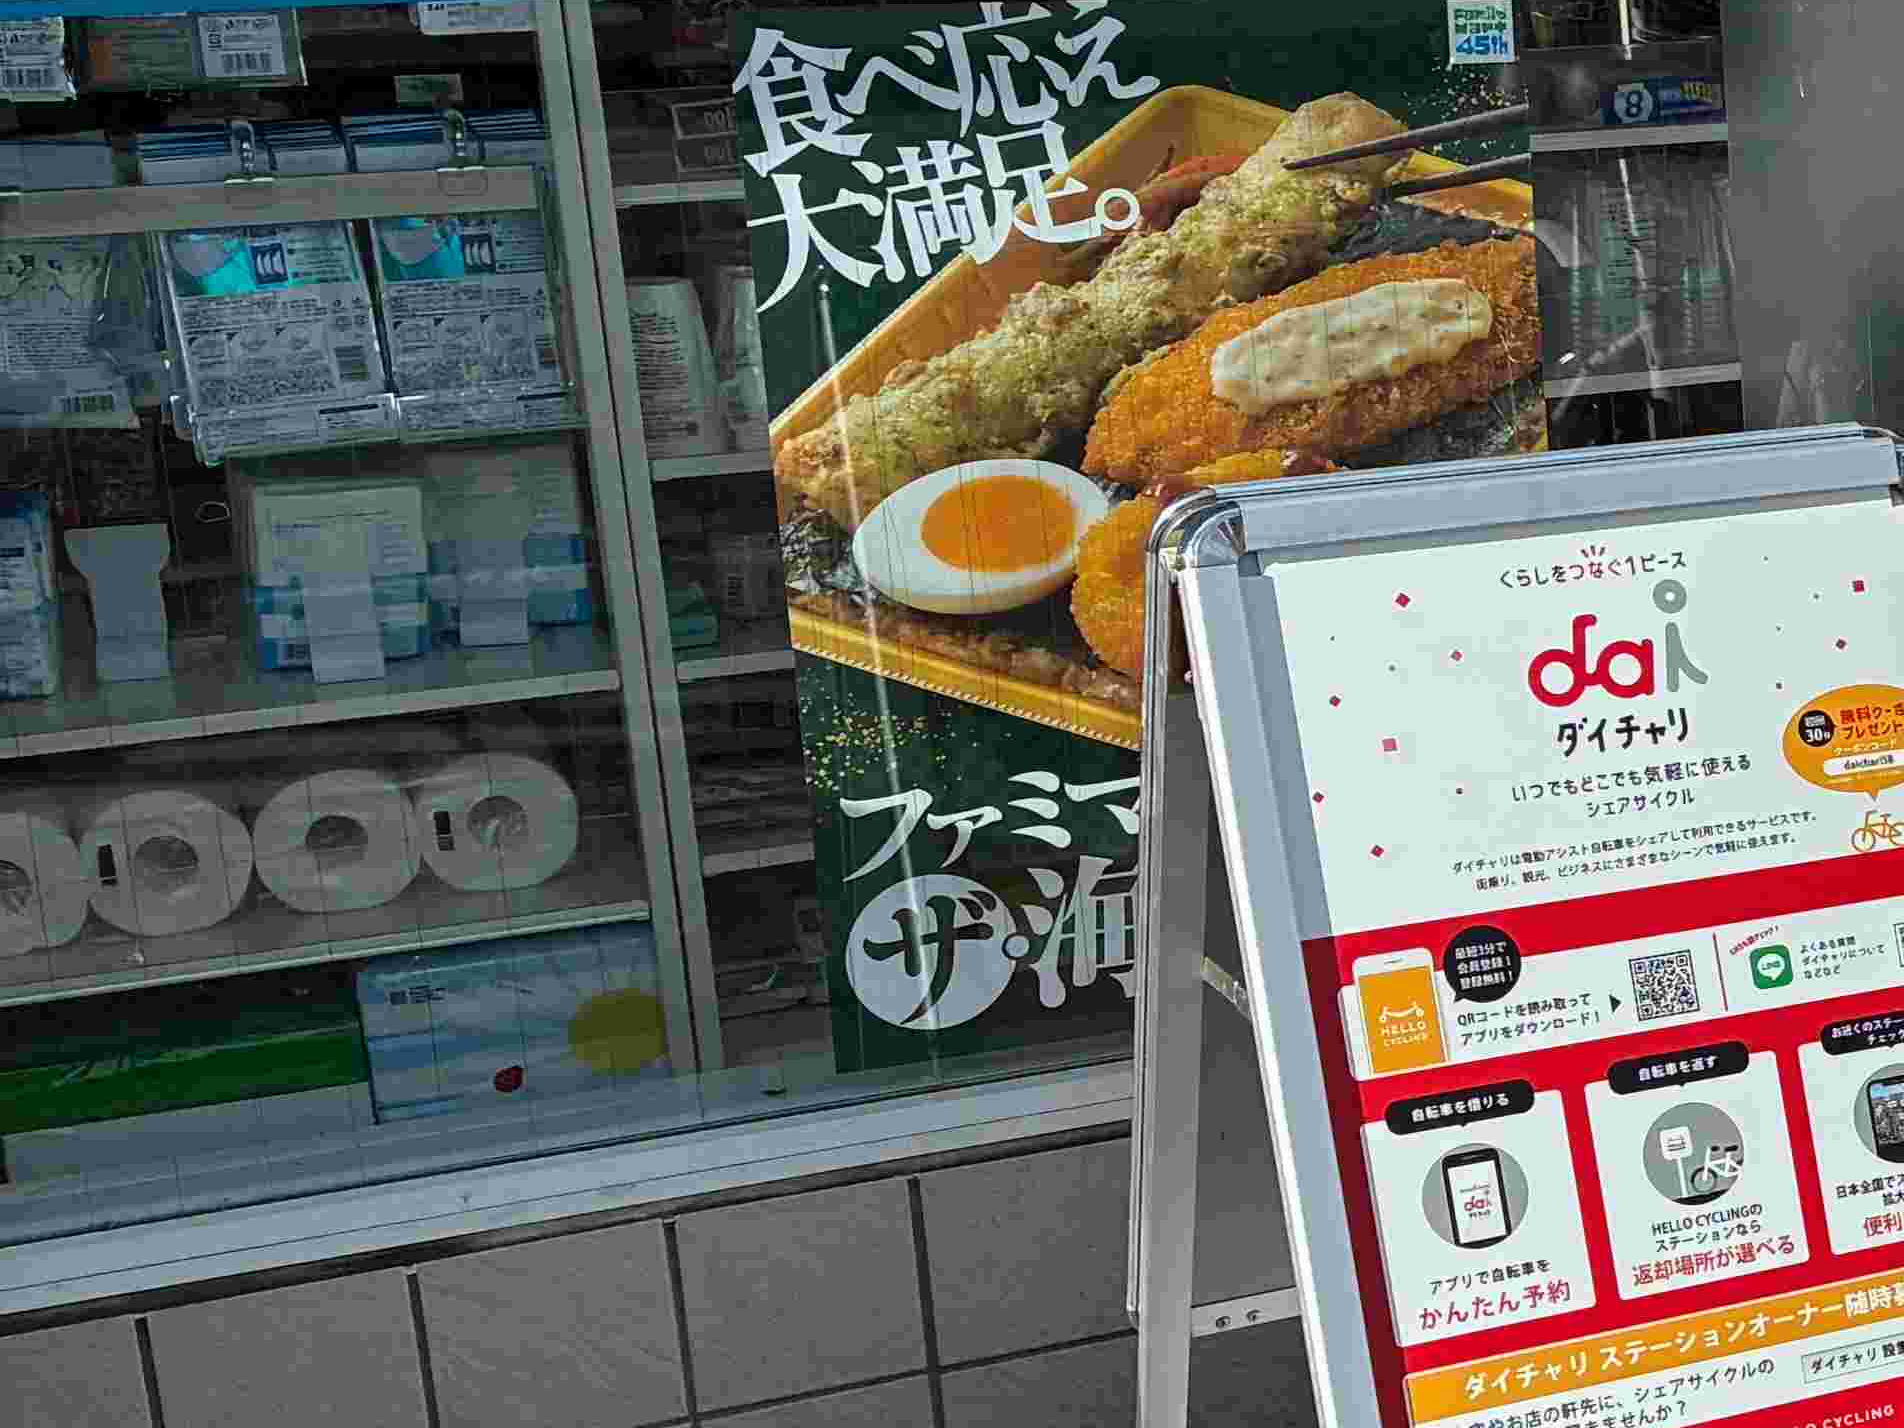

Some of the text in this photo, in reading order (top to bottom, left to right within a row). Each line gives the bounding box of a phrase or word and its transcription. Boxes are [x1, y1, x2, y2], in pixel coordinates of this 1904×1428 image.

[1455, 35, 1509, 55] 45th
[733, 0, 1161, 173] 食べ応え
[746, 122, 1140, 312] 大満足。
[1528, 579, 1709, 708] dai
[1556, 708, 1689, 757] ダイチャリ
[1512, 753, 1752, 802] いつでもどこでも気軽に使える
[1586, 788, 1696, 819] シェアサイクル
[1380, 1018, 1427, 1037] HELLO
[1457, 992, 1593, 1028] QRコードを読み取って
[1460, 1010, 1601, 1047] アプリをダウンロード！
[1638, 1054, 1719, 1082] 自転車を返す
[1411, 1093, 1511, 1123] 自転車を借りる
[1651, 1215, 1693, 1238] HELLO
[1655, 1221, 1762, 1253] ステーションなら
[1429, 1258, 1551, 1296] アプリで自転車を
[1631, 1235, 1796, 1287] 返却場所が選べる
[1418, 1279, 1571, 1331] かんたん予約
[1463, 1348, 1588, 1401] ダイチャリ
[1809, 1346, 1878, 1375] ダイチャリ
